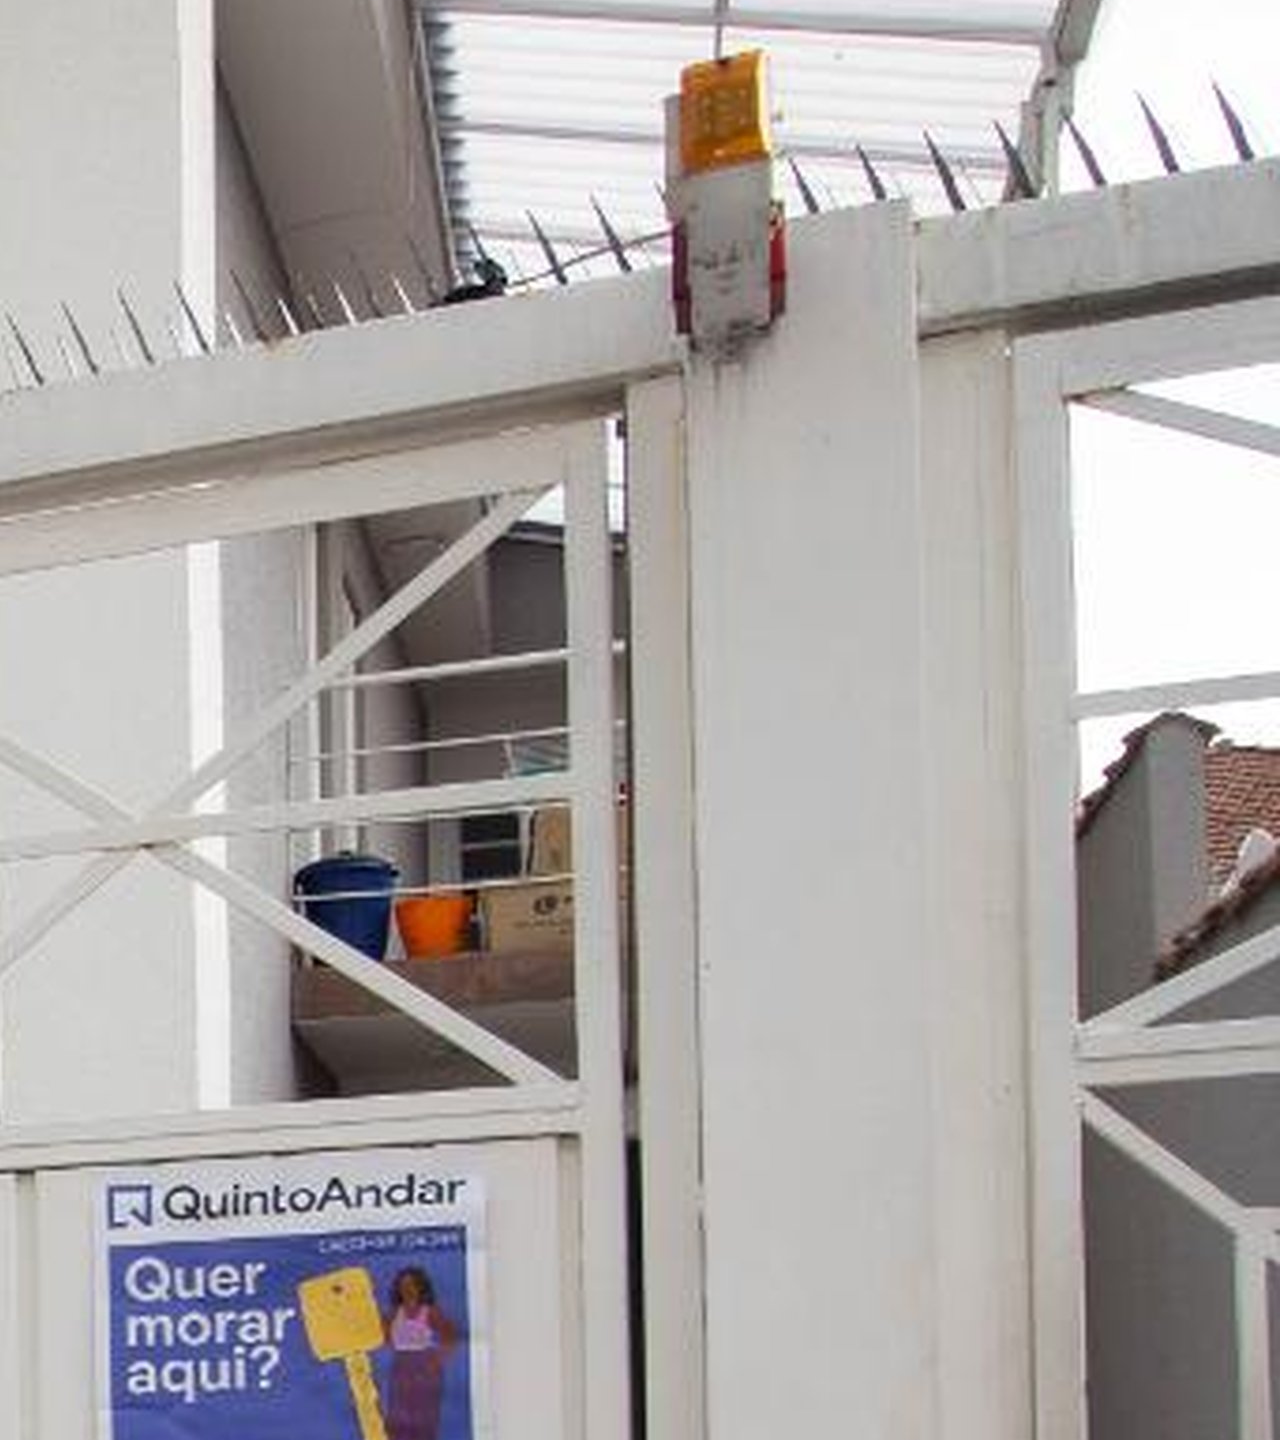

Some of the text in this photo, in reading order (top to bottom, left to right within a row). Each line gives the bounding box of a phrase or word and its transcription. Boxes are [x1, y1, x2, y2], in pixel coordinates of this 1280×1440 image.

[163, 1174, 466, 1221] QuintoAndar
[125, 1256, 266, 1302] Quer
[127, 1308, 295, 1347] morar
[127, 1345, 281, 1403] aqui?
